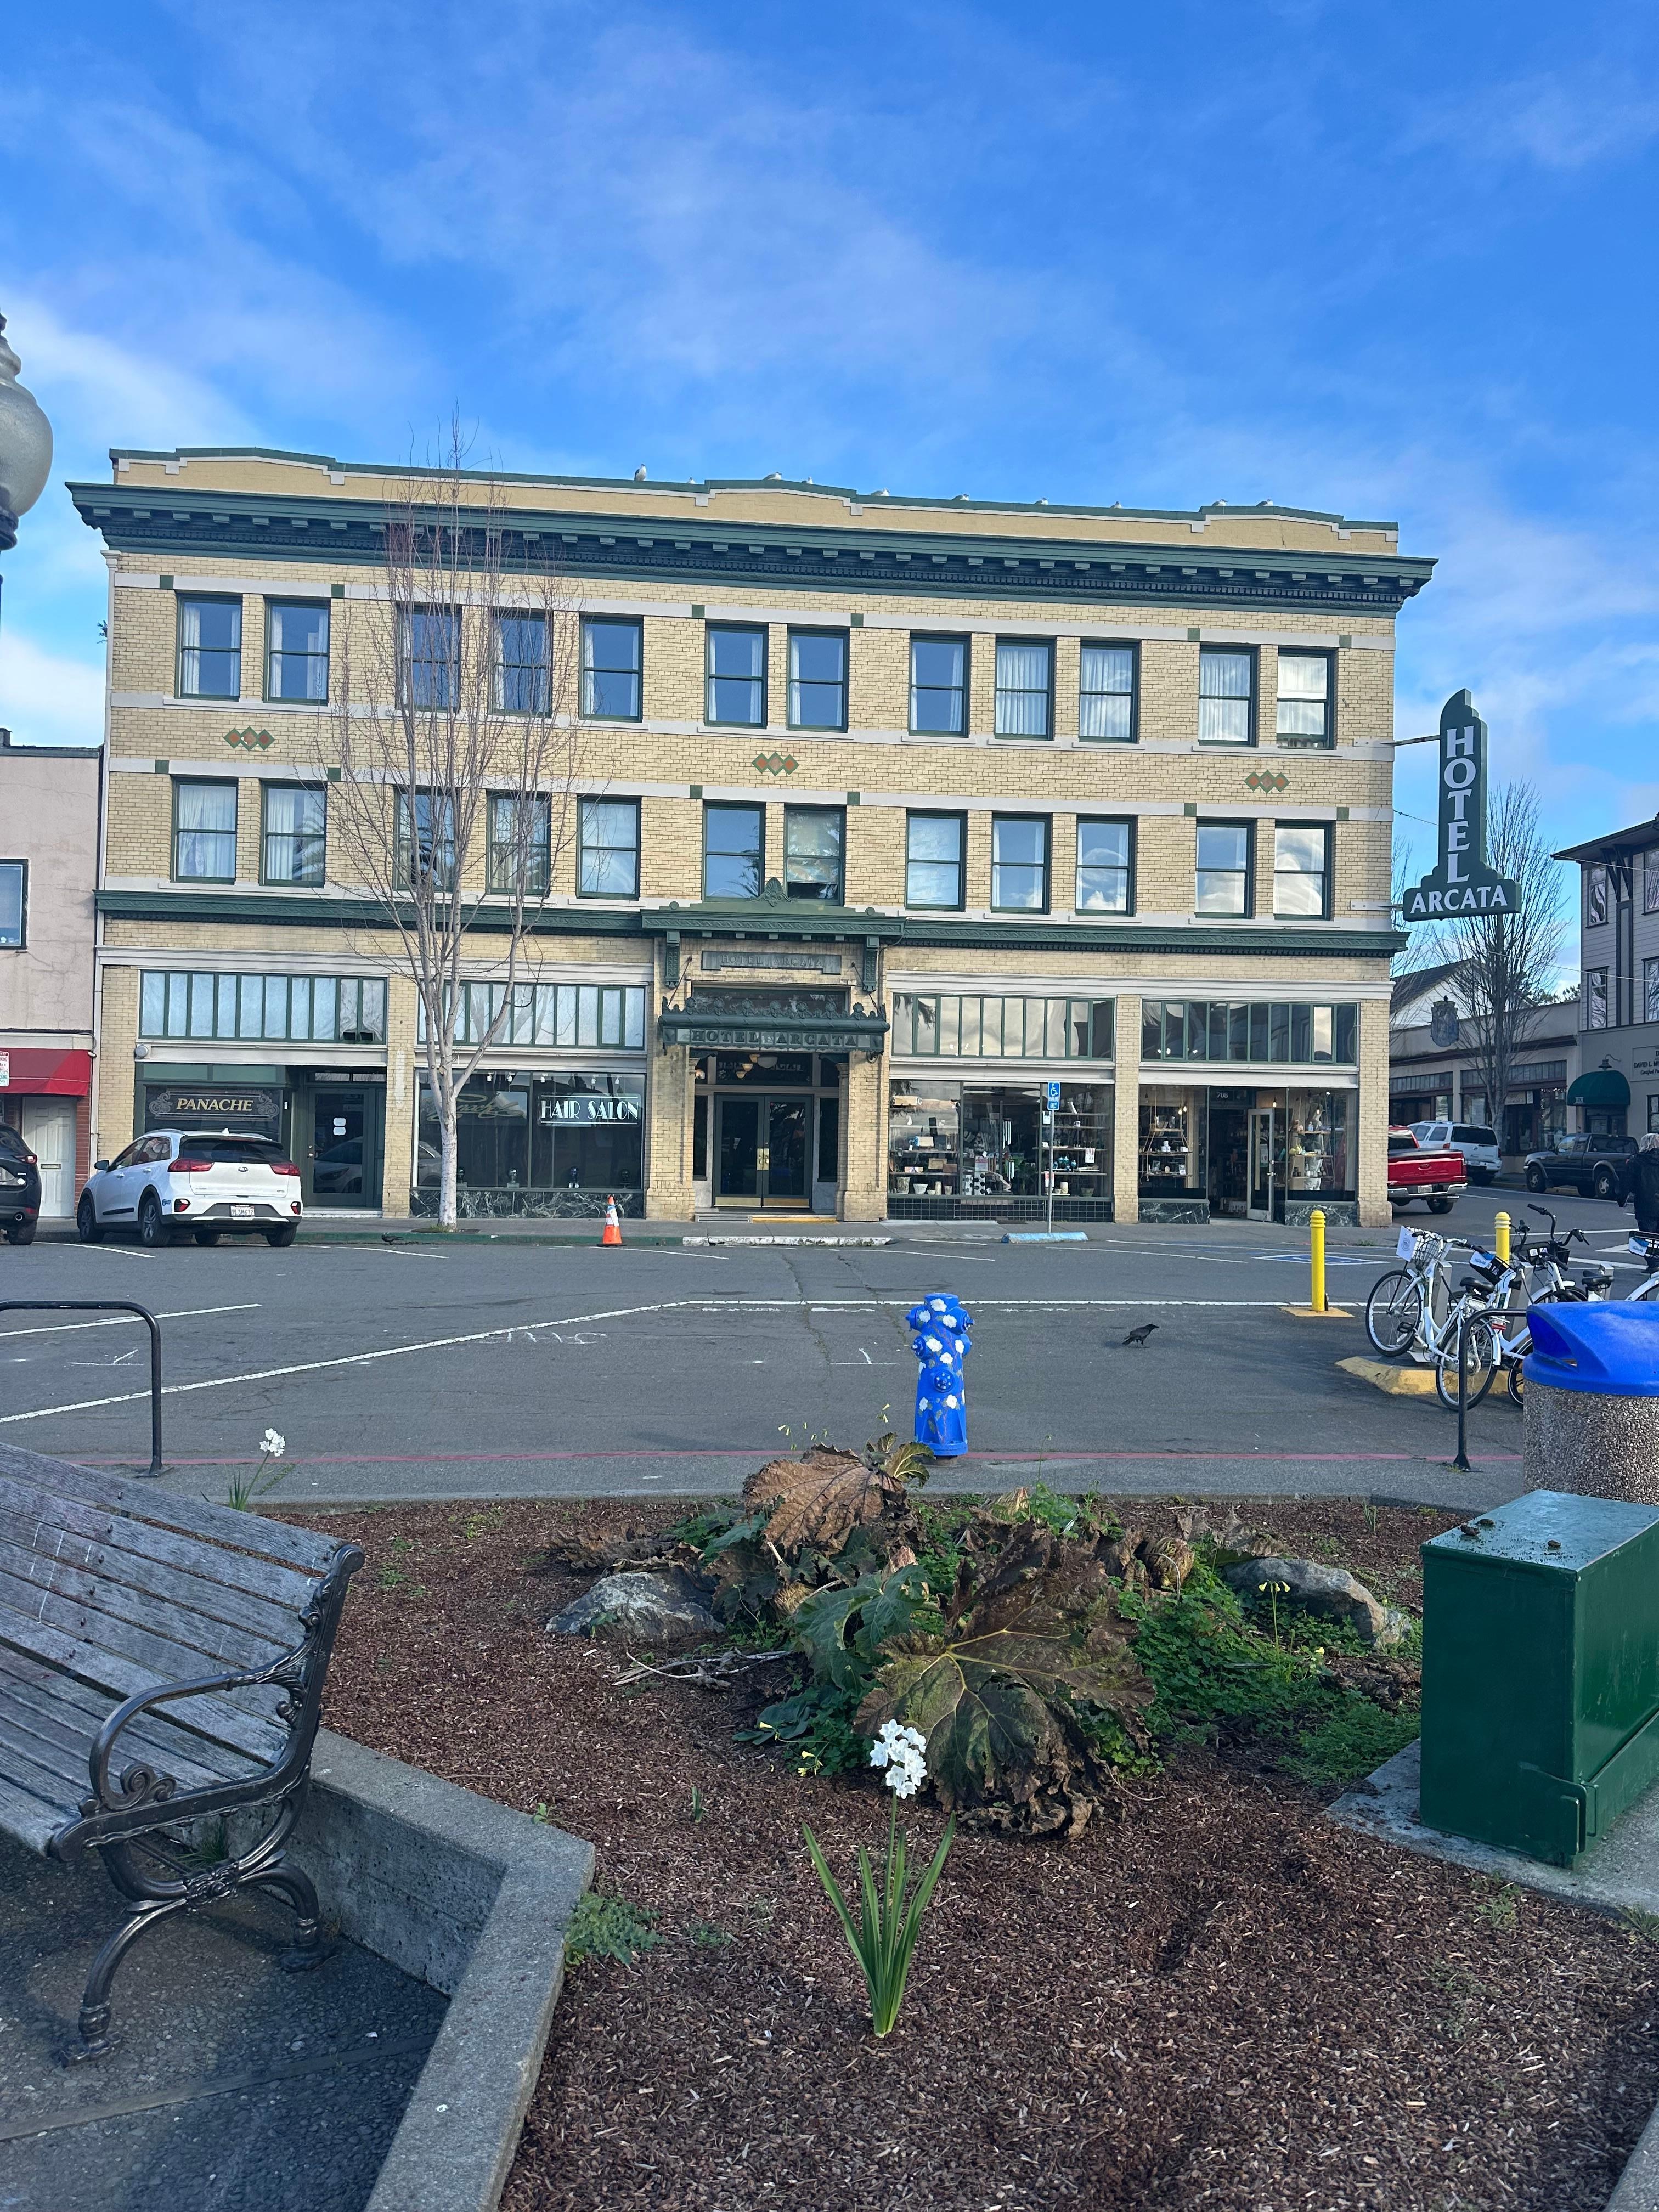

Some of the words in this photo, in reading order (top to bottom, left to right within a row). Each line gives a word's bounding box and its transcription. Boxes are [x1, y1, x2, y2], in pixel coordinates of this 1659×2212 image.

[1443, 725, 1477, 884] HOTEL
[1410, 885, 1508, 915] ARCATA
[720, 955, 763, 964] HOTEL
[772, 957, 825, 967] ARCATA
[691, 1030, 759, 1043] HOTEL
[776, 1031, 857, 1046] ARCATA
[176, 1098, 253, 1111] PANACHE
[540, 1100, 580, 1119] HAIR
[587, 1101, 639, 1120] SALON
